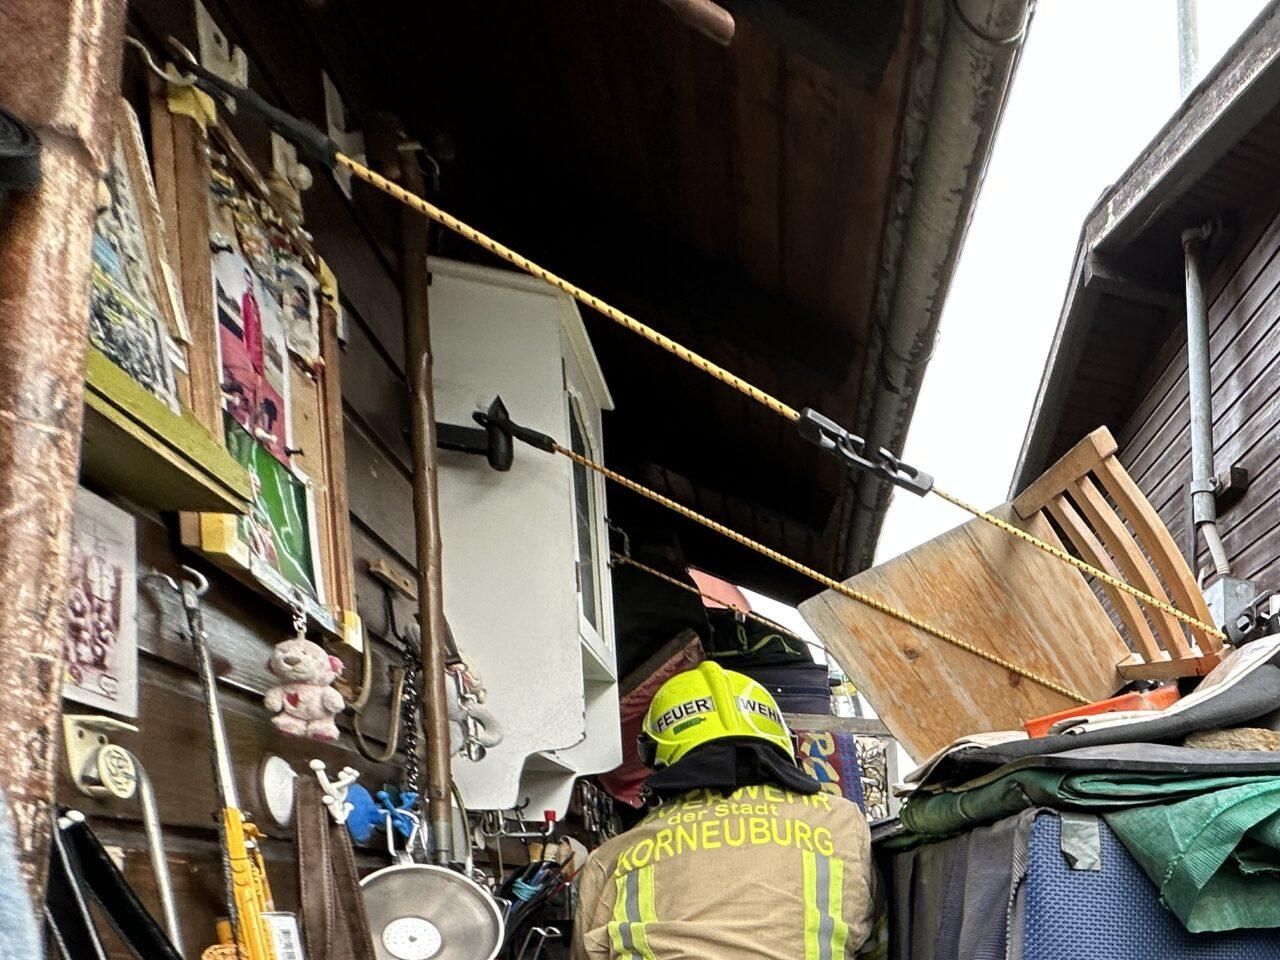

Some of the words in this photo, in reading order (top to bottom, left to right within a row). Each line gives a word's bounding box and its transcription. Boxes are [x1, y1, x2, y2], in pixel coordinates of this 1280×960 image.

[656, 699, 710, 733] FEUER
[667, 810, 708, 825] der
[714, 802, 779, 818] Stadt
[615, 817, 834, 878] KORNEUBURG
